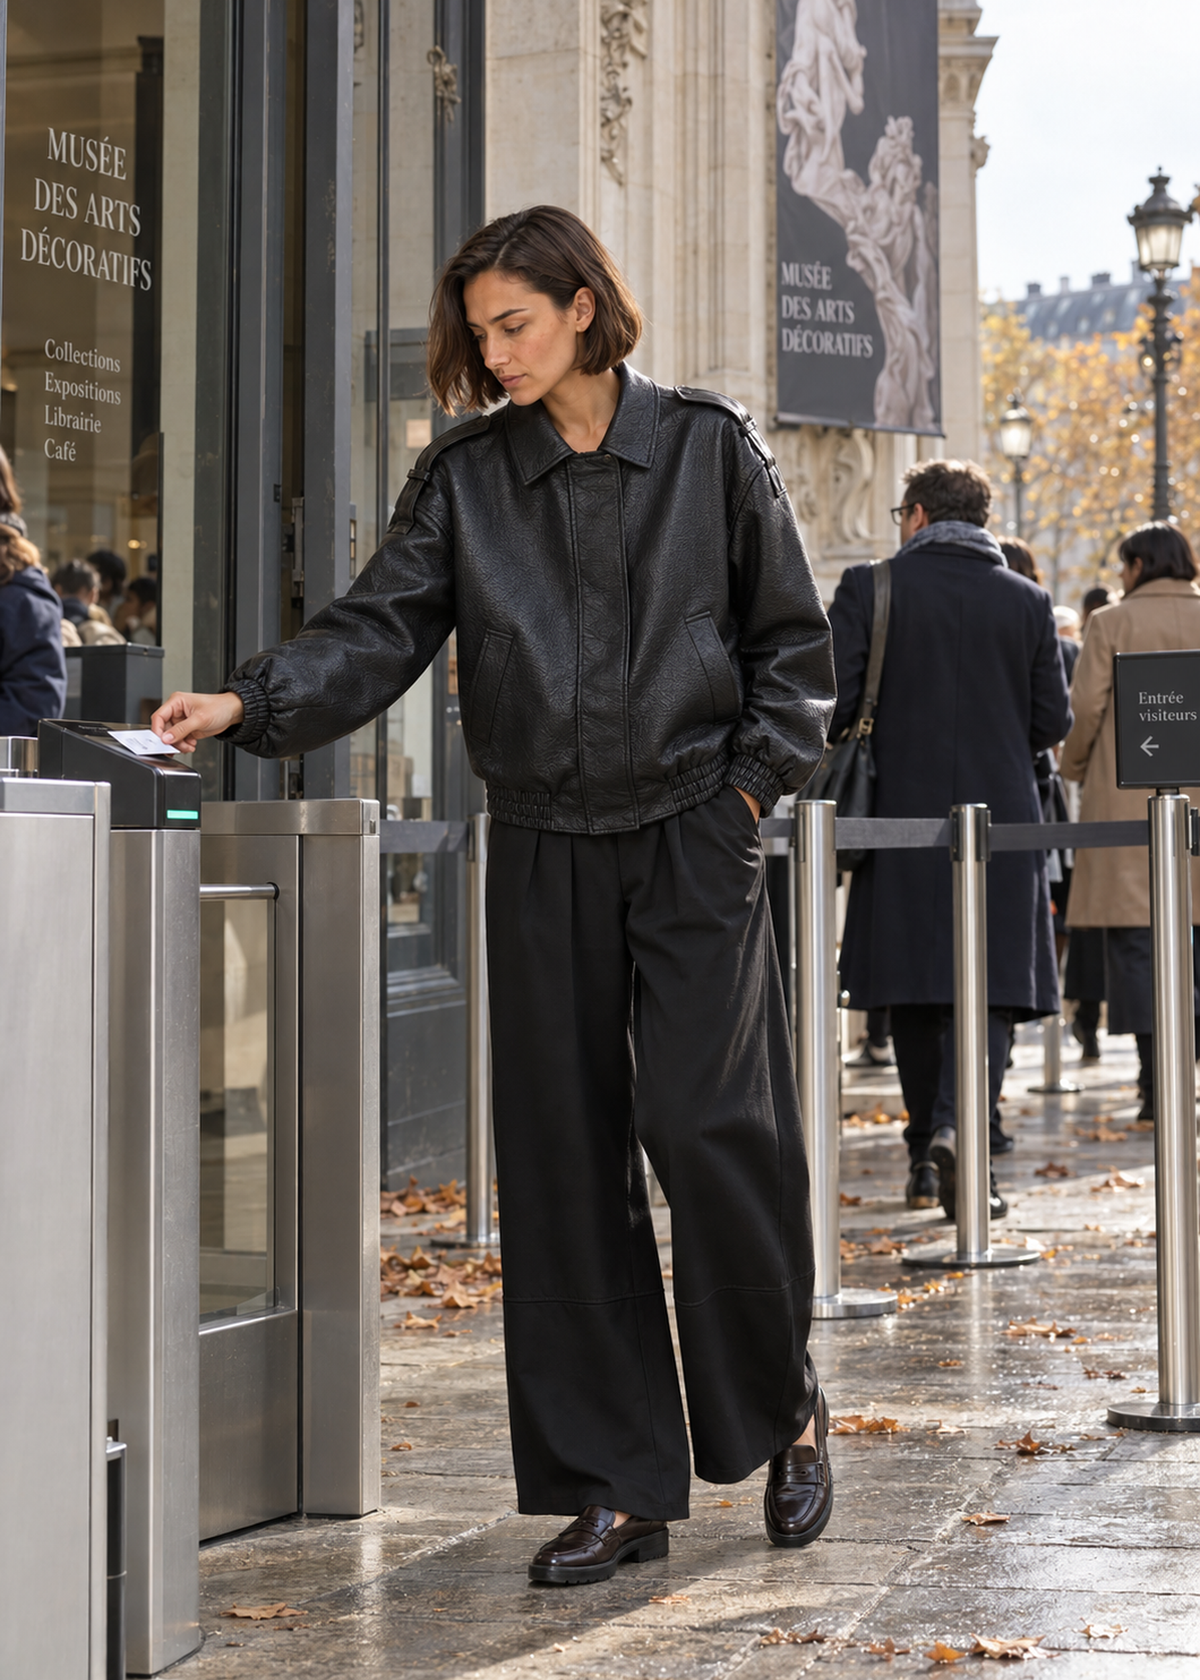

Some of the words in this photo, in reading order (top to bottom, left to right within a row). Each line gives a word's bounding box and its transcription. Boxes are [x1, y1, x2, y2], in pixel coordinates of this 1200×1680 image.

[47, 127, 127, 180] MUSÉE
[34, 177, 78, 220] DES
[84, 192, 141, 237] ARTS
[20, 226, 152, 291] DÉCORATIFS
[781, 260, 832, 290] MUSÉE
[781, 294, 812, 321] DES
[814, 298, 855, 325] ARTS
[45, 338, 121, 373] Collections
[781, 324, 873, 358] DÉCORATIFS
[45, 371, 121, 405] Expositions
[45, 405, 102, 433] Librairie
[45, 437, 76, 461] Café
[1139, 691, 1184, 705] Entrée
[1139, 709, 1198, 722] visiteurs
